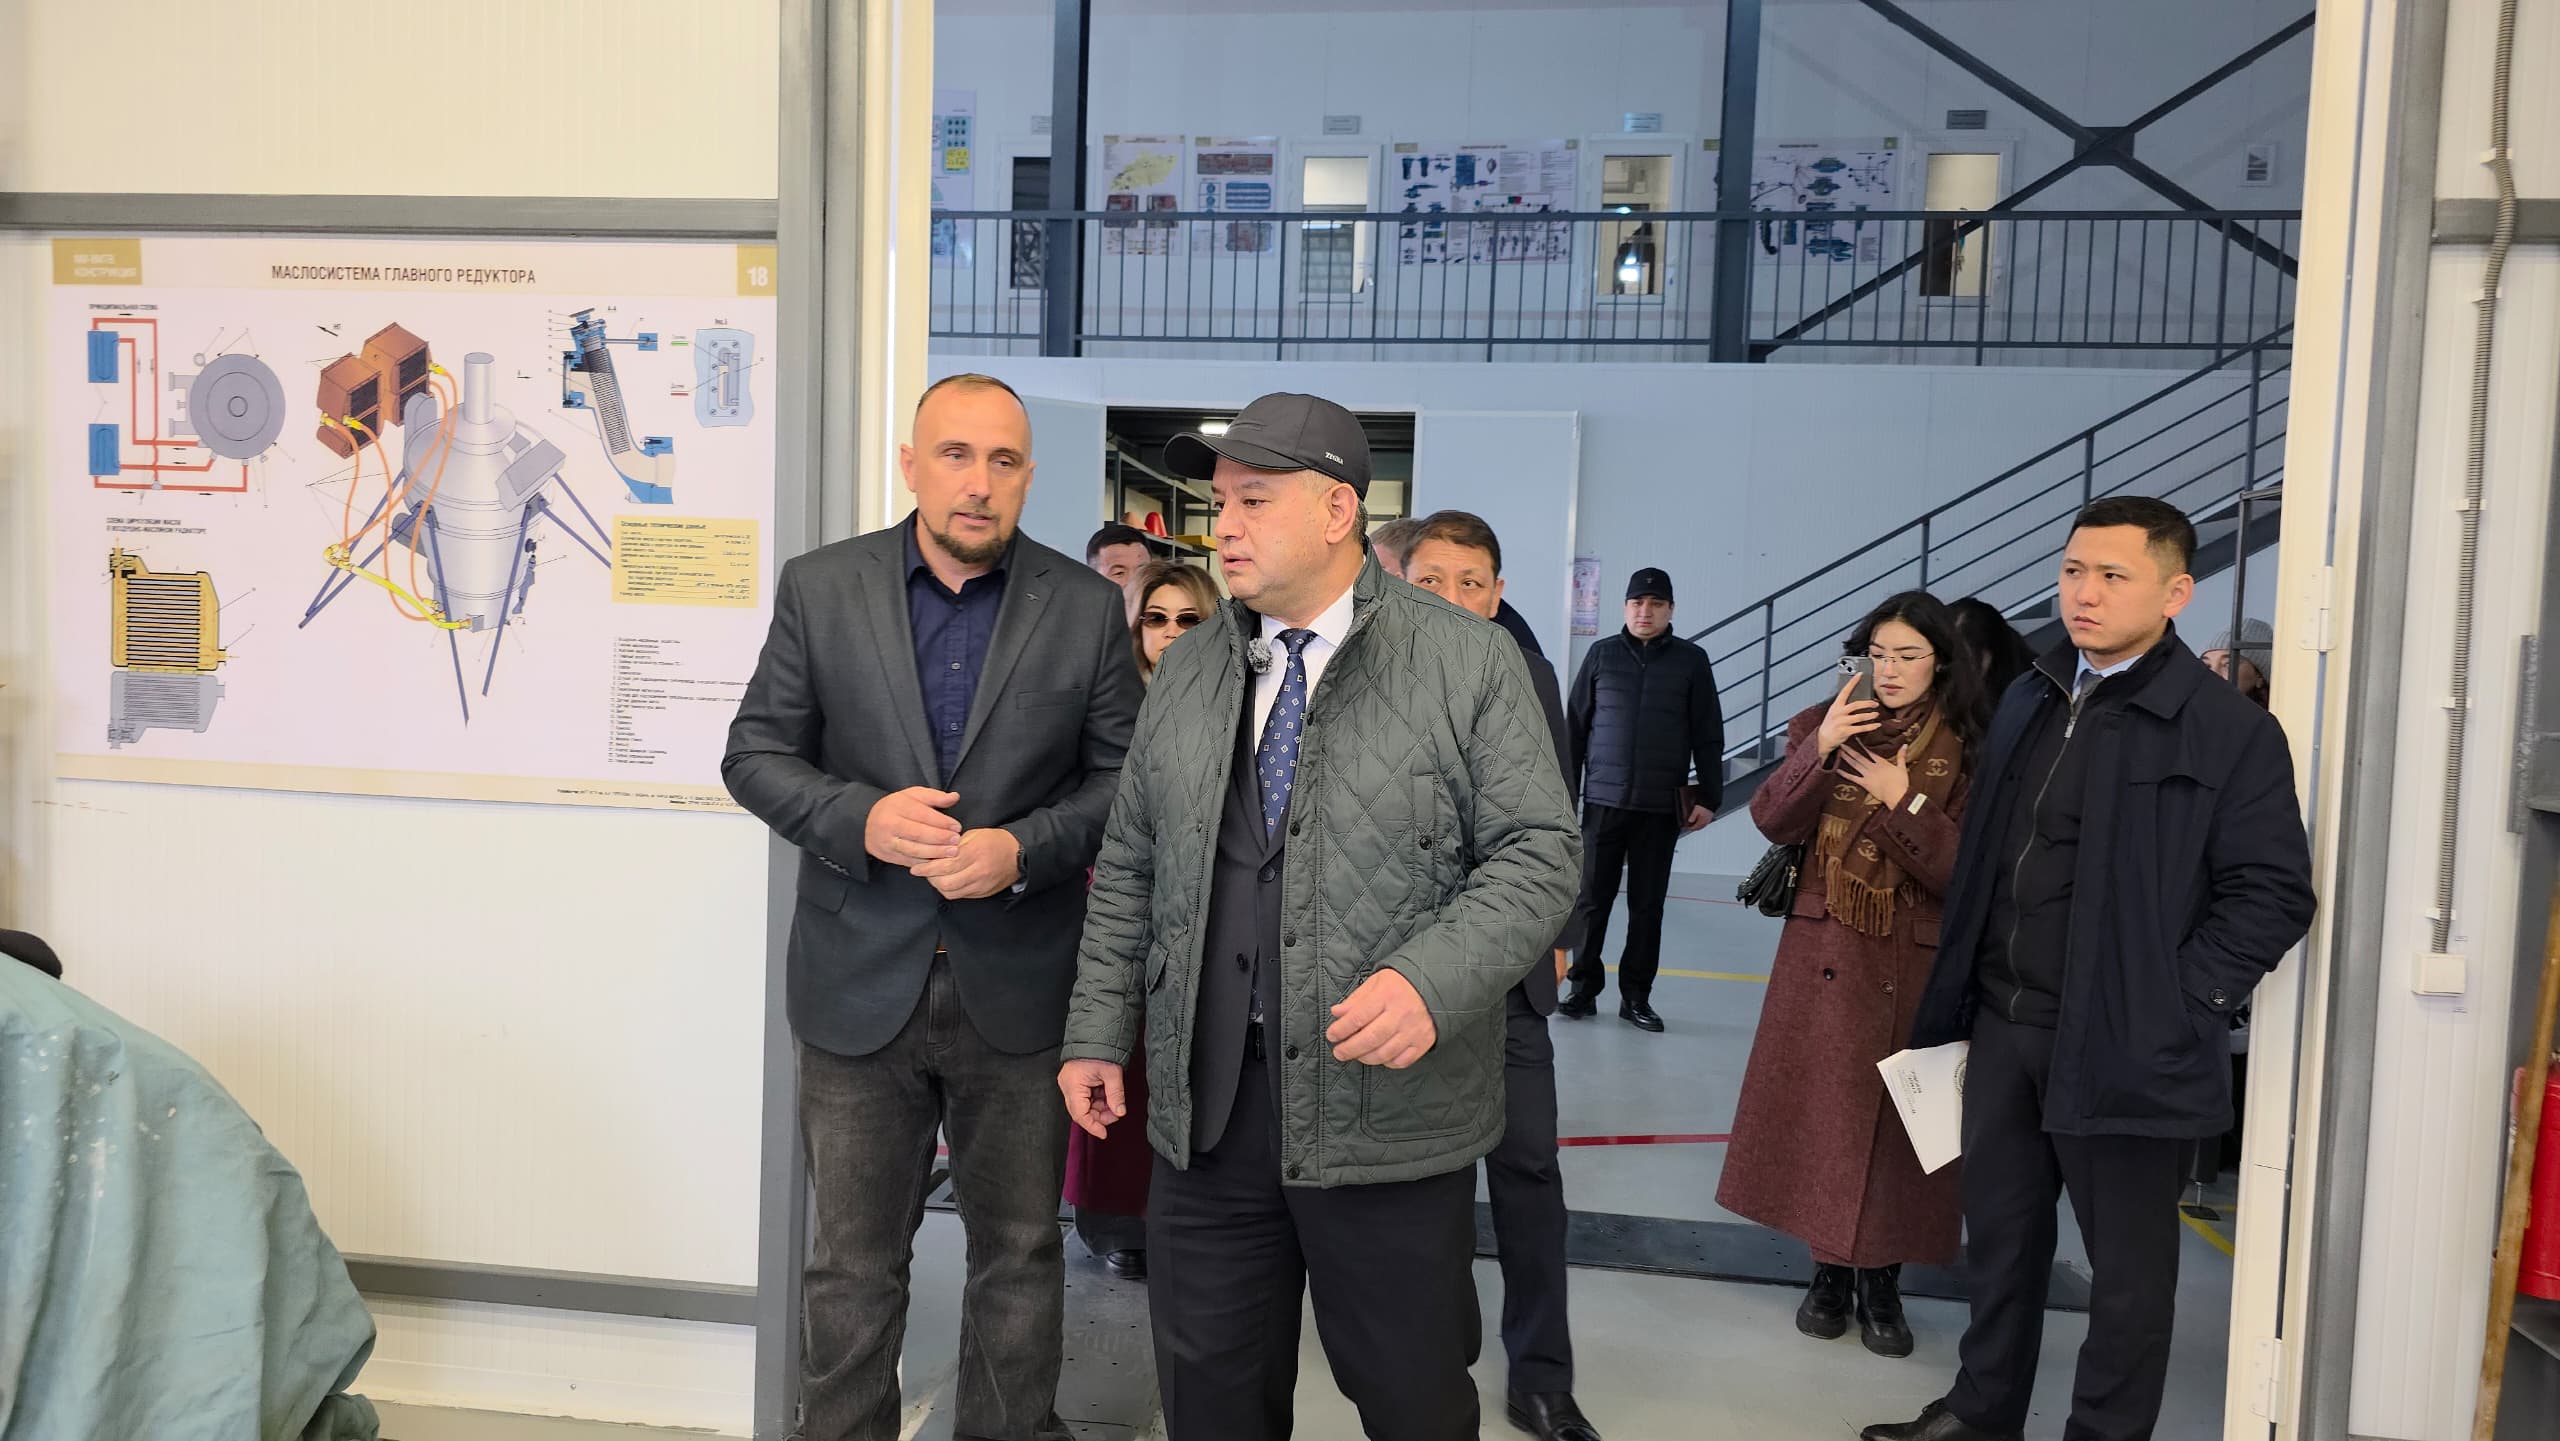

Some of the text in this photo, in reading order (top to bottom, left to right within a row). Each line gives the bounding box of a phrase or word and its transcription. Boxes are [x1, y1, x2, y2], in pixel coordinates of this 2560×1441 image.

[272, 265, 536, 285] МАСЛОСИСТЕМА ГЛАВНОГО РЕДУКТОРА
[747, 266, 768, 286] 18
